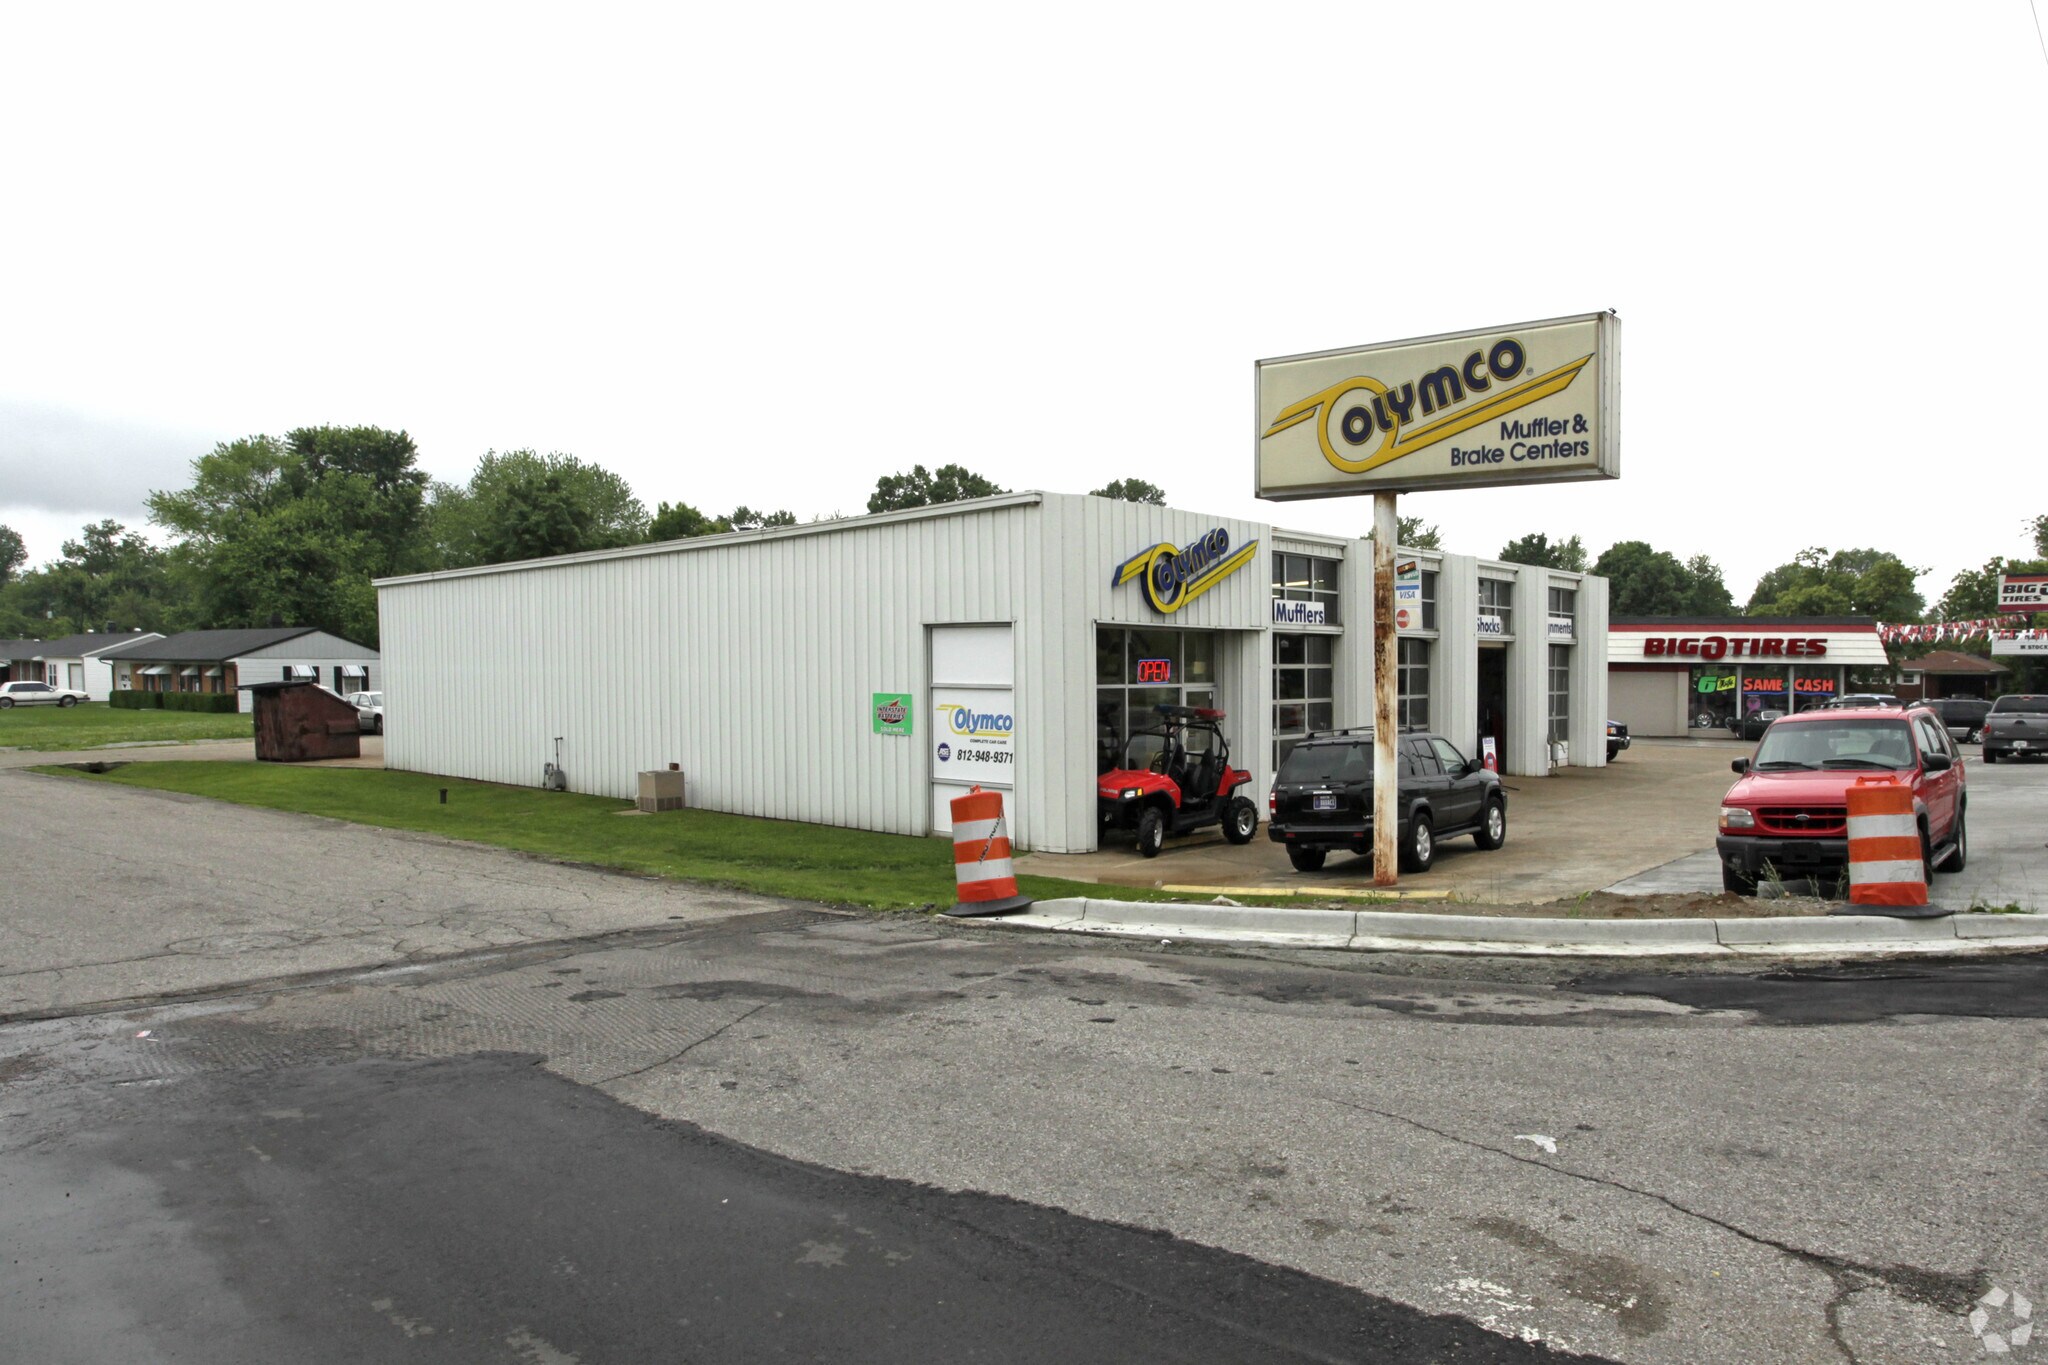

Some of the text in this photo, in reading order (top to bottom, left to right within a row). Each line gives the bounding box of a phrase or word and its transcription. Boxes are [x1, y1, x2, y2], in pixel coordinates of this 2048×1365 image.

[1341, 337, 1526, 445] OLYMCO
[1500, 413, 1588, 440] Muffler &
[1451, 439, 1589, 466] Brake Centers
[1154, 527, 1229, 592] OLYMCO
[1400, 591, 1415, 599] VISA
[2003, 584, 2037, 594] BIG
[1276, 602, 1324, 623] Mufflers
[1139, 661, 1169, 682] OPEN
[1743, 678, 1783, 691] SAME
[1794, 678, 1834, 691] CASH
[955, 708, 1013, 734] Olymco
[957, 749, 1013, 764] 812-948-9371
